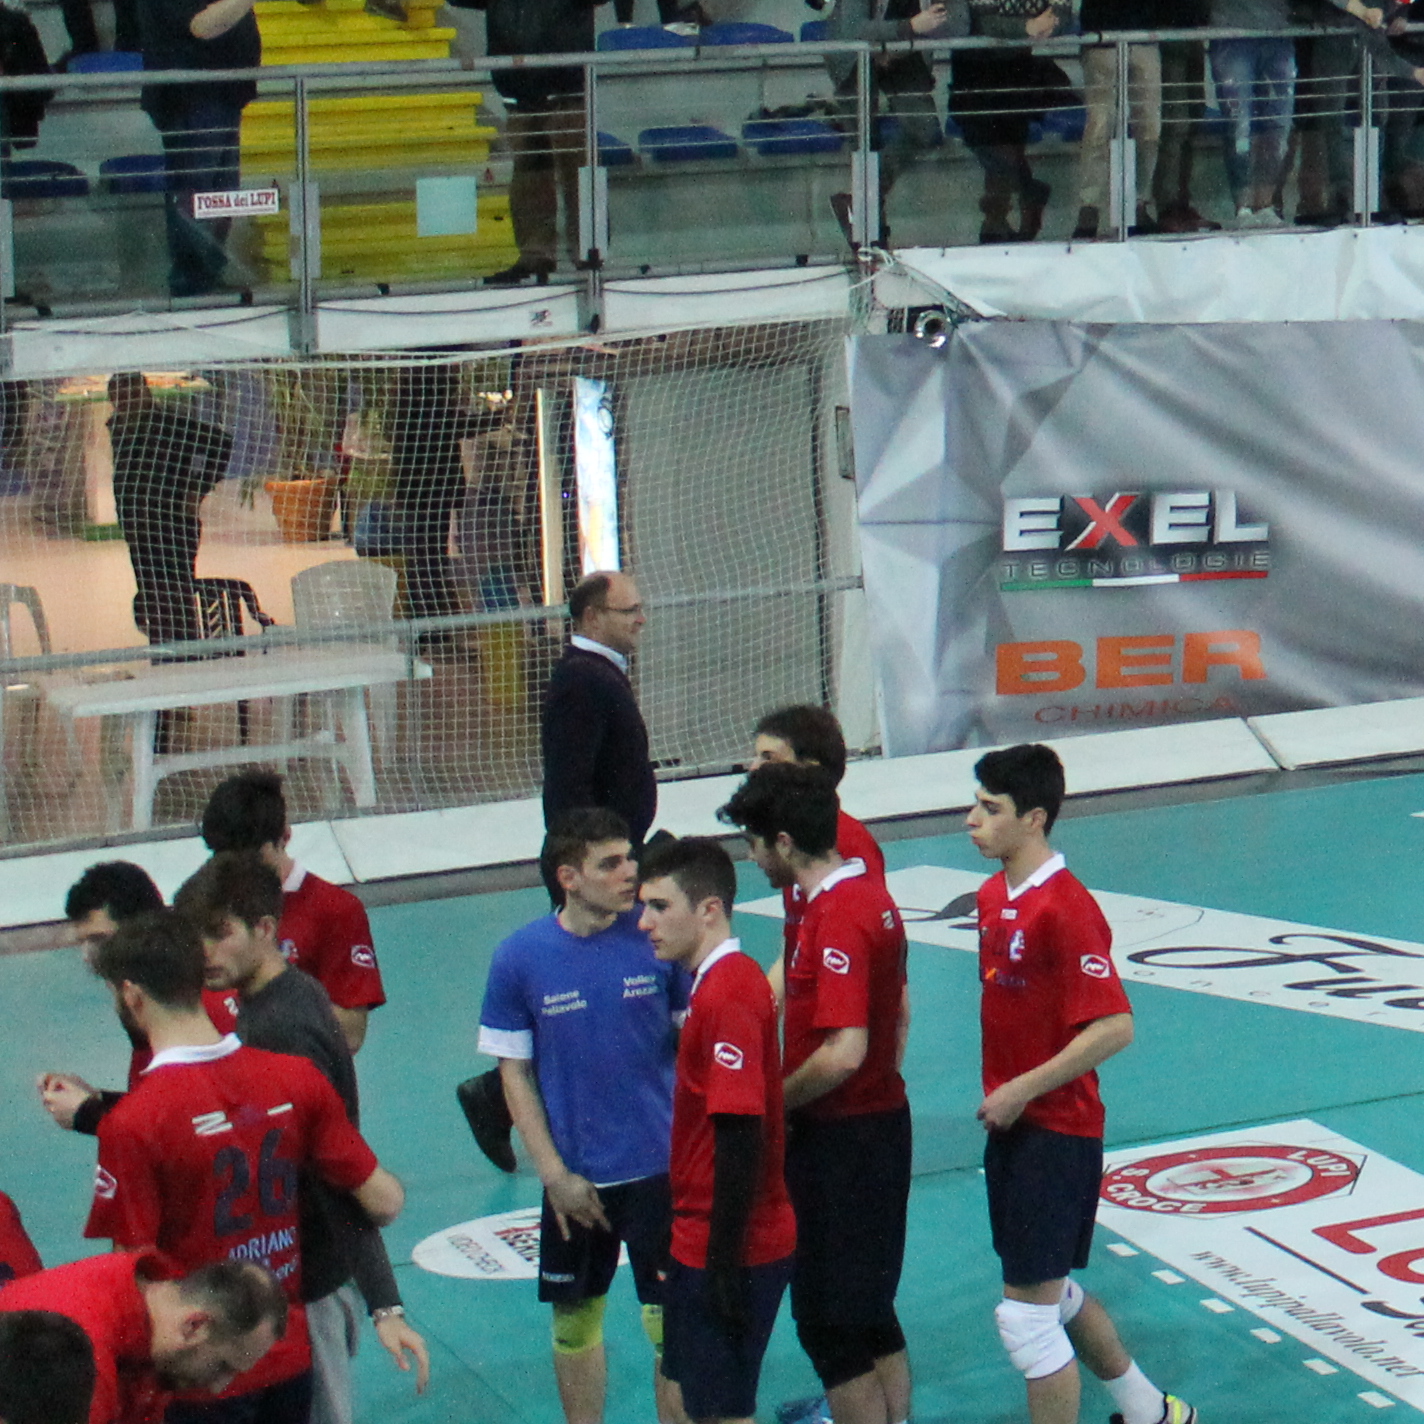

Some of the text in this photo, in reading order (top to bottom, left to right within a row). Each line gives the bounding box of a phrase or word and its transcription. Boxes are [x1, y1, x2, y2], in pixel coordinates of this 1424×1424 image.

[250, 192, 276, 206] LUPI
[1002, 489, 1271, 552] EXEL
[1002, 550, 1272, 578] TECNOLOGIE
[994, 629, 1270, 696] BER
[1033, 695, 1240, 725] CHIMICA
[212, 1126, 298, 1238] 26
[1105, 1181, 1208, 1214] CROCE
[1286, 1149, 1354, 1178] LUPI
